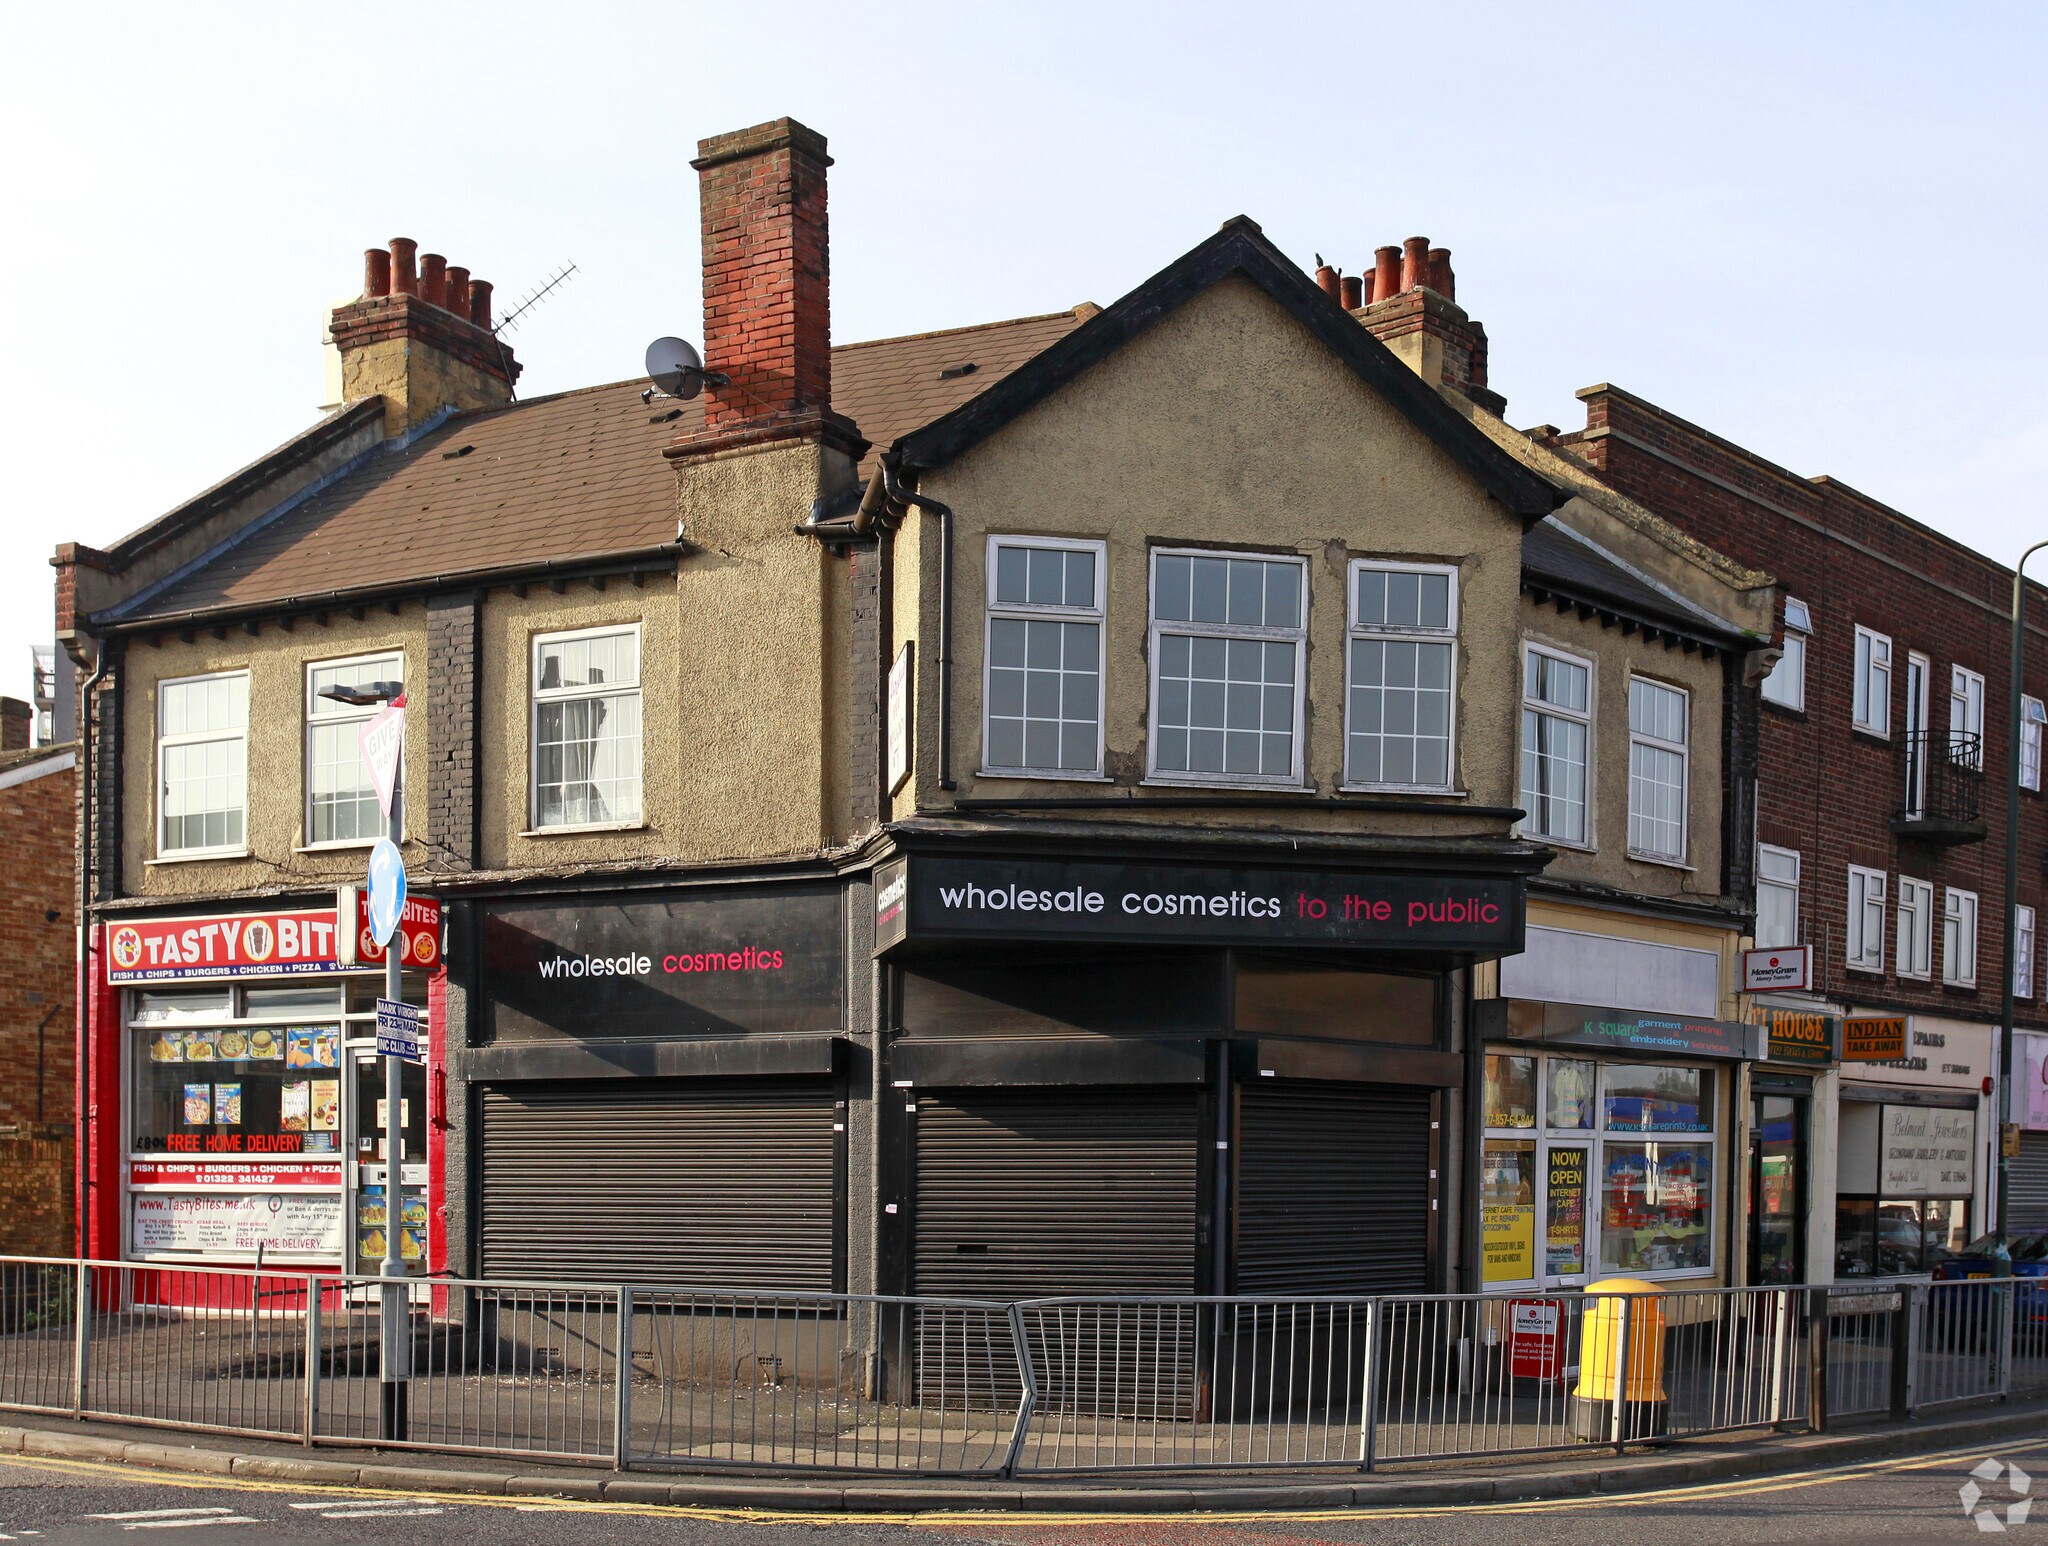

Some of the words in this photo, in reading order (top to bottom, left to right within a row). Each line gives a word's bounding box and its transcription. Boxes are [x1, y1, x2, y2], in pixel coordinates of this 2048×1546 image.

[369, 720, 395, 755] GIVE
[402, 901, 438, 924] BITES
[939, 882, 1105, 914] wholesale
[1121, 889, 1281, 920] cosmetics
[1297, 892, 1327, 920] to
[1343, 893, 1391, 922] the
[1407, 897, 1500, 927] public
[144, 921, 241, 964] TASTY
[277, 919, 337, 958] BIT
[538, 952, 651, 978] wholesale
[663, 946, 784, 974] cosmetics
[113, 971, 134, 980] FISH
[136, 971, 143, 979] &
[146, 970, 175, 978] CHIPS
[184, 967, 230, 977] BURGERS
[239, 965, 283, 975] CHICKEN
[292, 963, 321, 972] PIZZA
[1751, 967, 1798, 976] MoneyGram
[378, 1002, 397, 1016] MARK
[378, 1016, 389, 1028] FRI
[403, 1021, 418, 1032] MAR
[1584, 1021, 1593, 1034] K
[1600, 1021, 1640, 1040] square
[1638, 1019, 1682, 1030] garment
[1684, 1023, 1723, 1036] printing
[1772, 1009, 1825, 1042] HOUSE
[1847, 1021, 1904, 1037] INDIAN
[378, 1038, 390, 1052] INC
[390, 1040, 406, 1054] CLUB
[1630, 1035, 1689, 1048] embroidery
[1691, 1041, 1730, 1053] services
[1847, 1042, 1872, 1052] TAKE
[1874, 1040, 1903, 1052] AWAY
[1890, 1112, 1927, 1137] Belmont
[1929, 1115, 1968, 1145] Jewellers
[167, 1133, 200, 1152] FREE
[205, 1134, 242, 1151] HOME
[247, 1134, 302, 1151] DELIVERY
[1552, 1152, 1581, 1166] NOW
[134, 1164, 154, 1173] FISH
[157, 1164, 164, 1173] &
[166, 1164, 196, 1173] CHIPS
[205, 1164, 250, 1173] BURGERS
[259, 1164, 303, 1173] CHICKEN
[312, 1164, 341, 1173] PIZZA
[203, 1174, 234, 1183] 01322
[238, 1174, 275, 1183] 341427
[1550, 1170, 1582, 1184] OPEN
[1549, 1188, 1582, 1197] INTERNET
[140, 1197, 255, 1215] www.TastyBites.me.uk
[1556, 1199, 1576, 1208] CAFE
[1550, 1225, 1579, 1235] T-SHIRTS
[235, 1237, 255, 1248] FREE
[282, 1238, 321, 1249] DELIVERY
